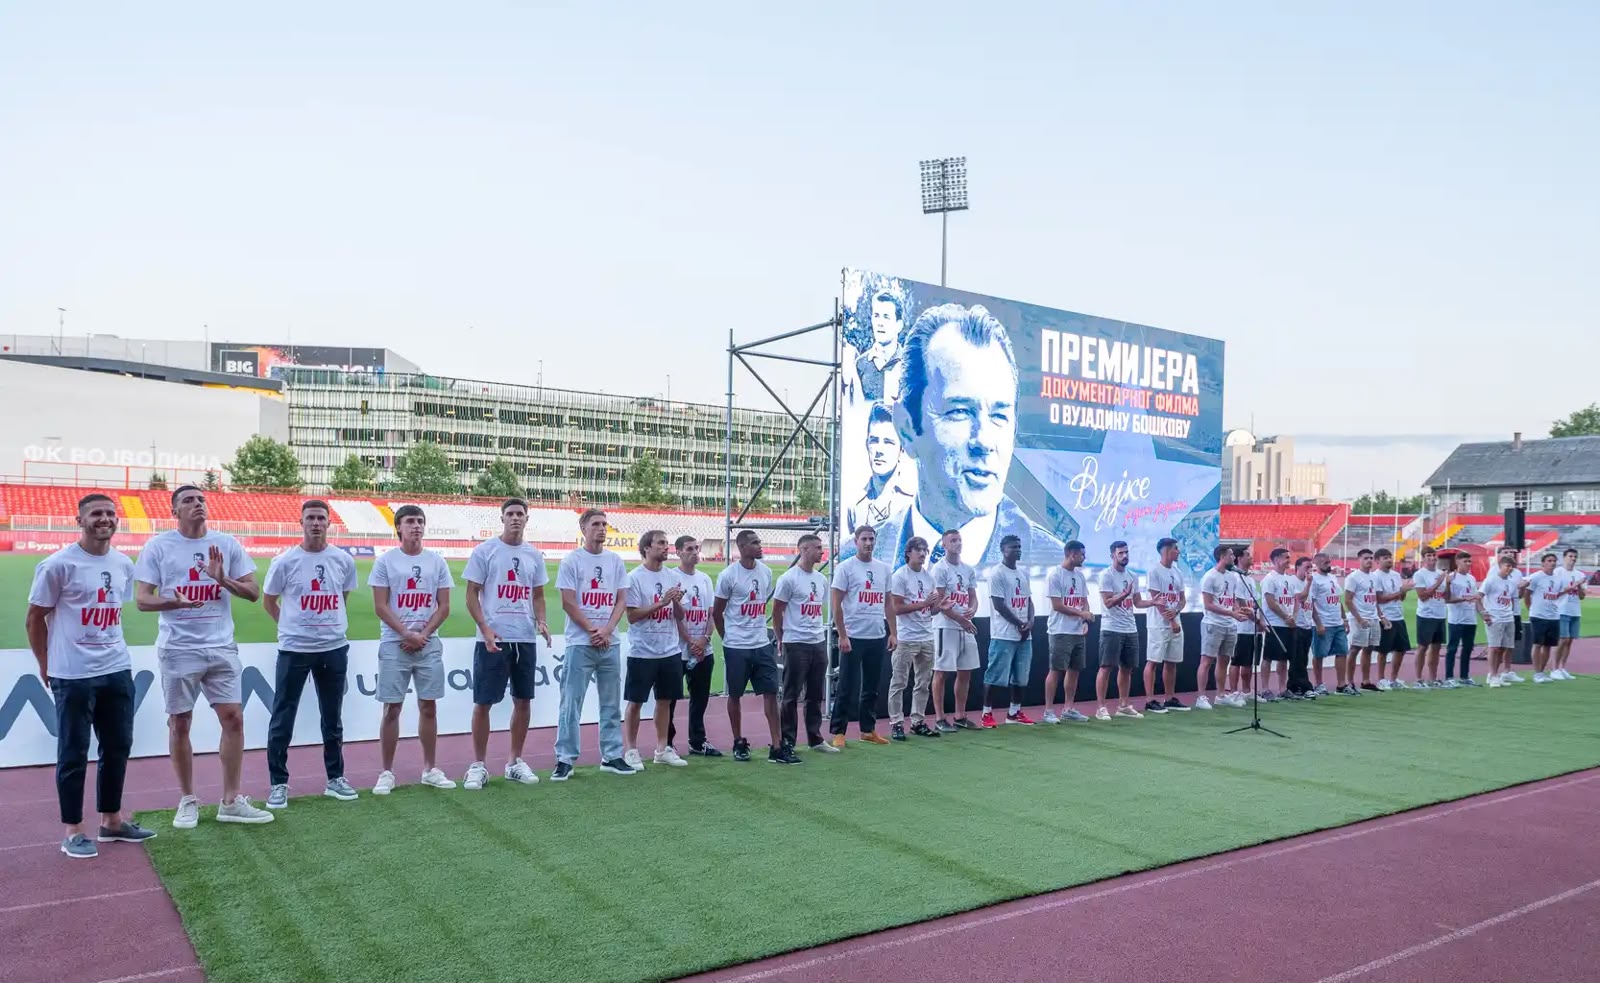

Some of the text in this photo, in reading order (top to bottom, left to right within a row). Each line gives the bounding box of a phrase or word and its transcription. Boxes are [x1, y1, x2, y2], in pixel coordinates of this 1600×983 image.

[226, 360, 253, 373] BIG
[1041, 328, 1199, 395] ПРЕМИЈЕРА
[1041, 376, 1199, 416] ДОКУМЕНТАРНОГ ФИЛМА
[1050, 403, 1191, 438] О ВУЈАДИНУ БОШКОВУ
[24, 445, 221, 471] ФК ВОЈВОДИНА
[398, 593, 432, 611] VUJKE
[498, 585, 530, 603] VUJKE
[582, 592, 613, 609] VUJKE
[859, 591, 884, 606] VUJKE
[301, 595, 338, 615] VUJKE
